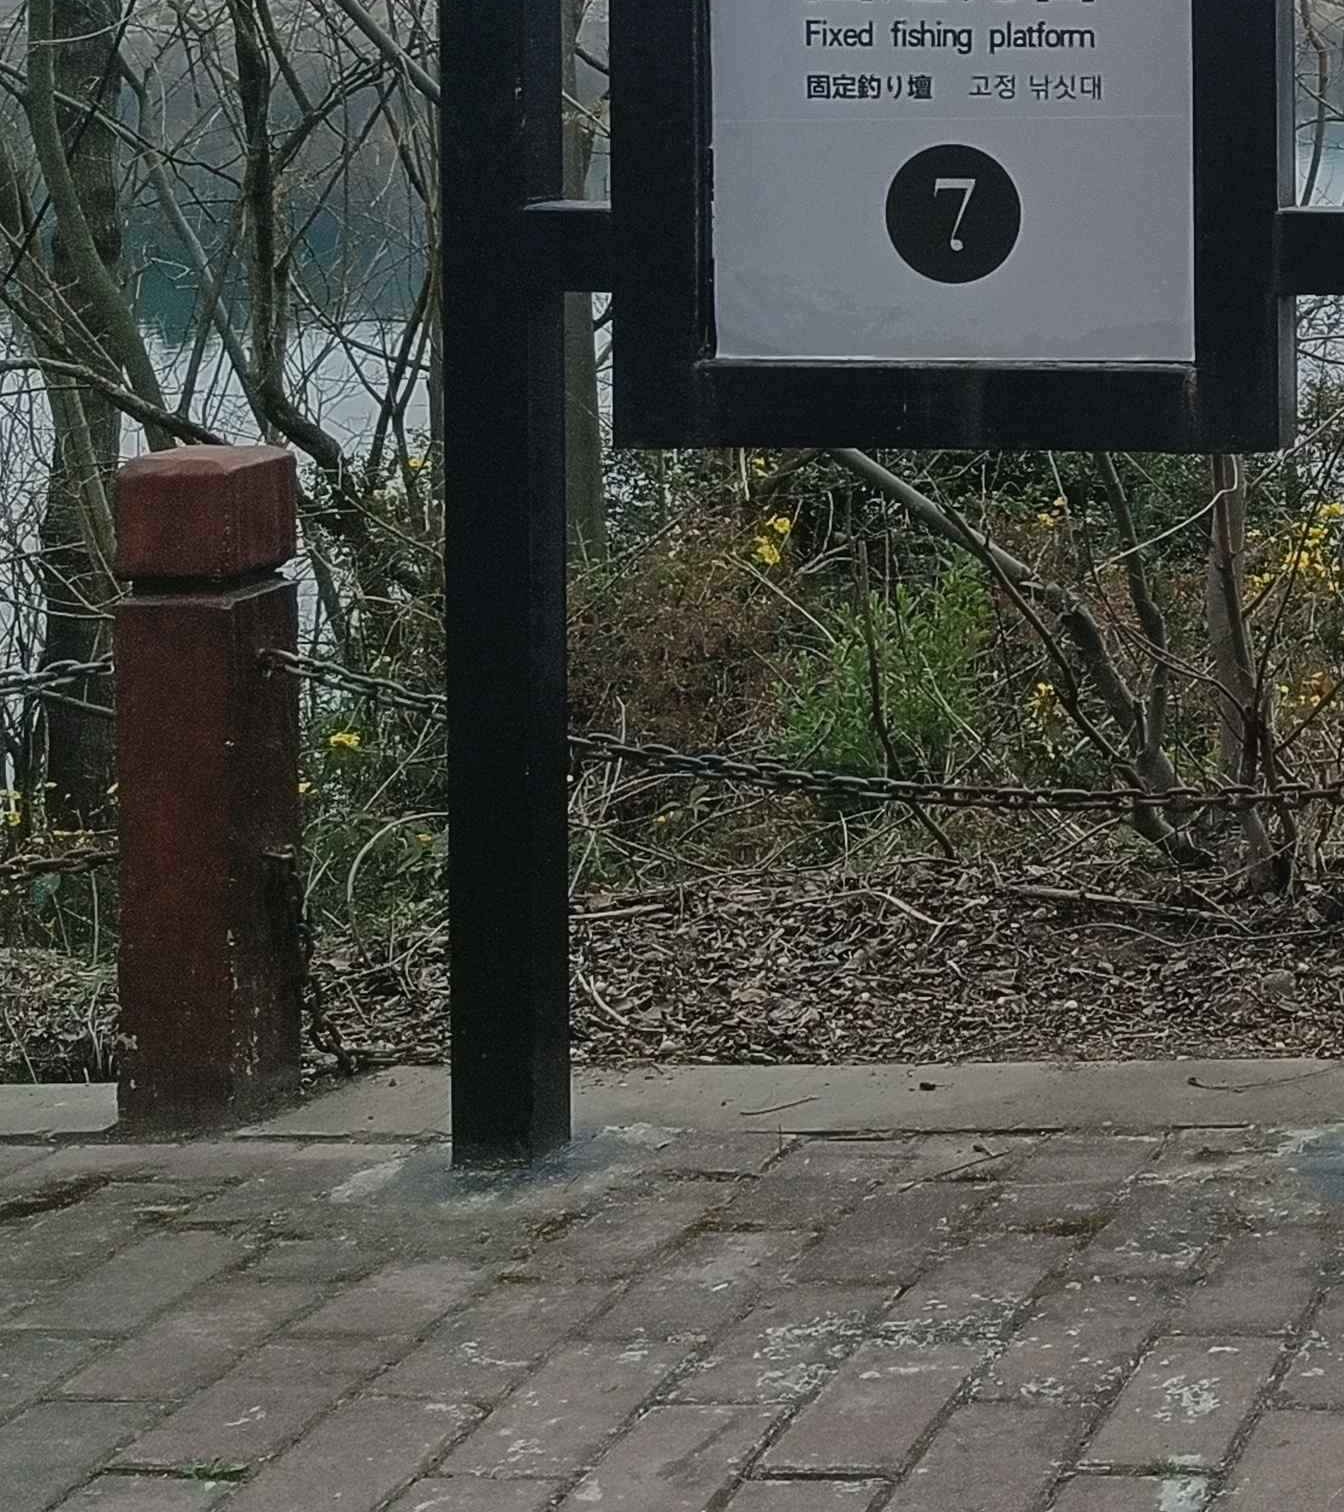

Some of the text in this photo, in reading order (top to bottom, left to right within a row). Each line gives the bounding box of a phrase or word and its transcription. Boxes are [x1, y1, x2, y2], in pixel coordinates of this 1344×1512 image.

[805, 20, 1096, 55] Fixed fishing platform
[806, 74, 933, 100] 固定釣り壇
[968, 74, 1016, 100] 고정
[934, 178, 976, 252] 7
